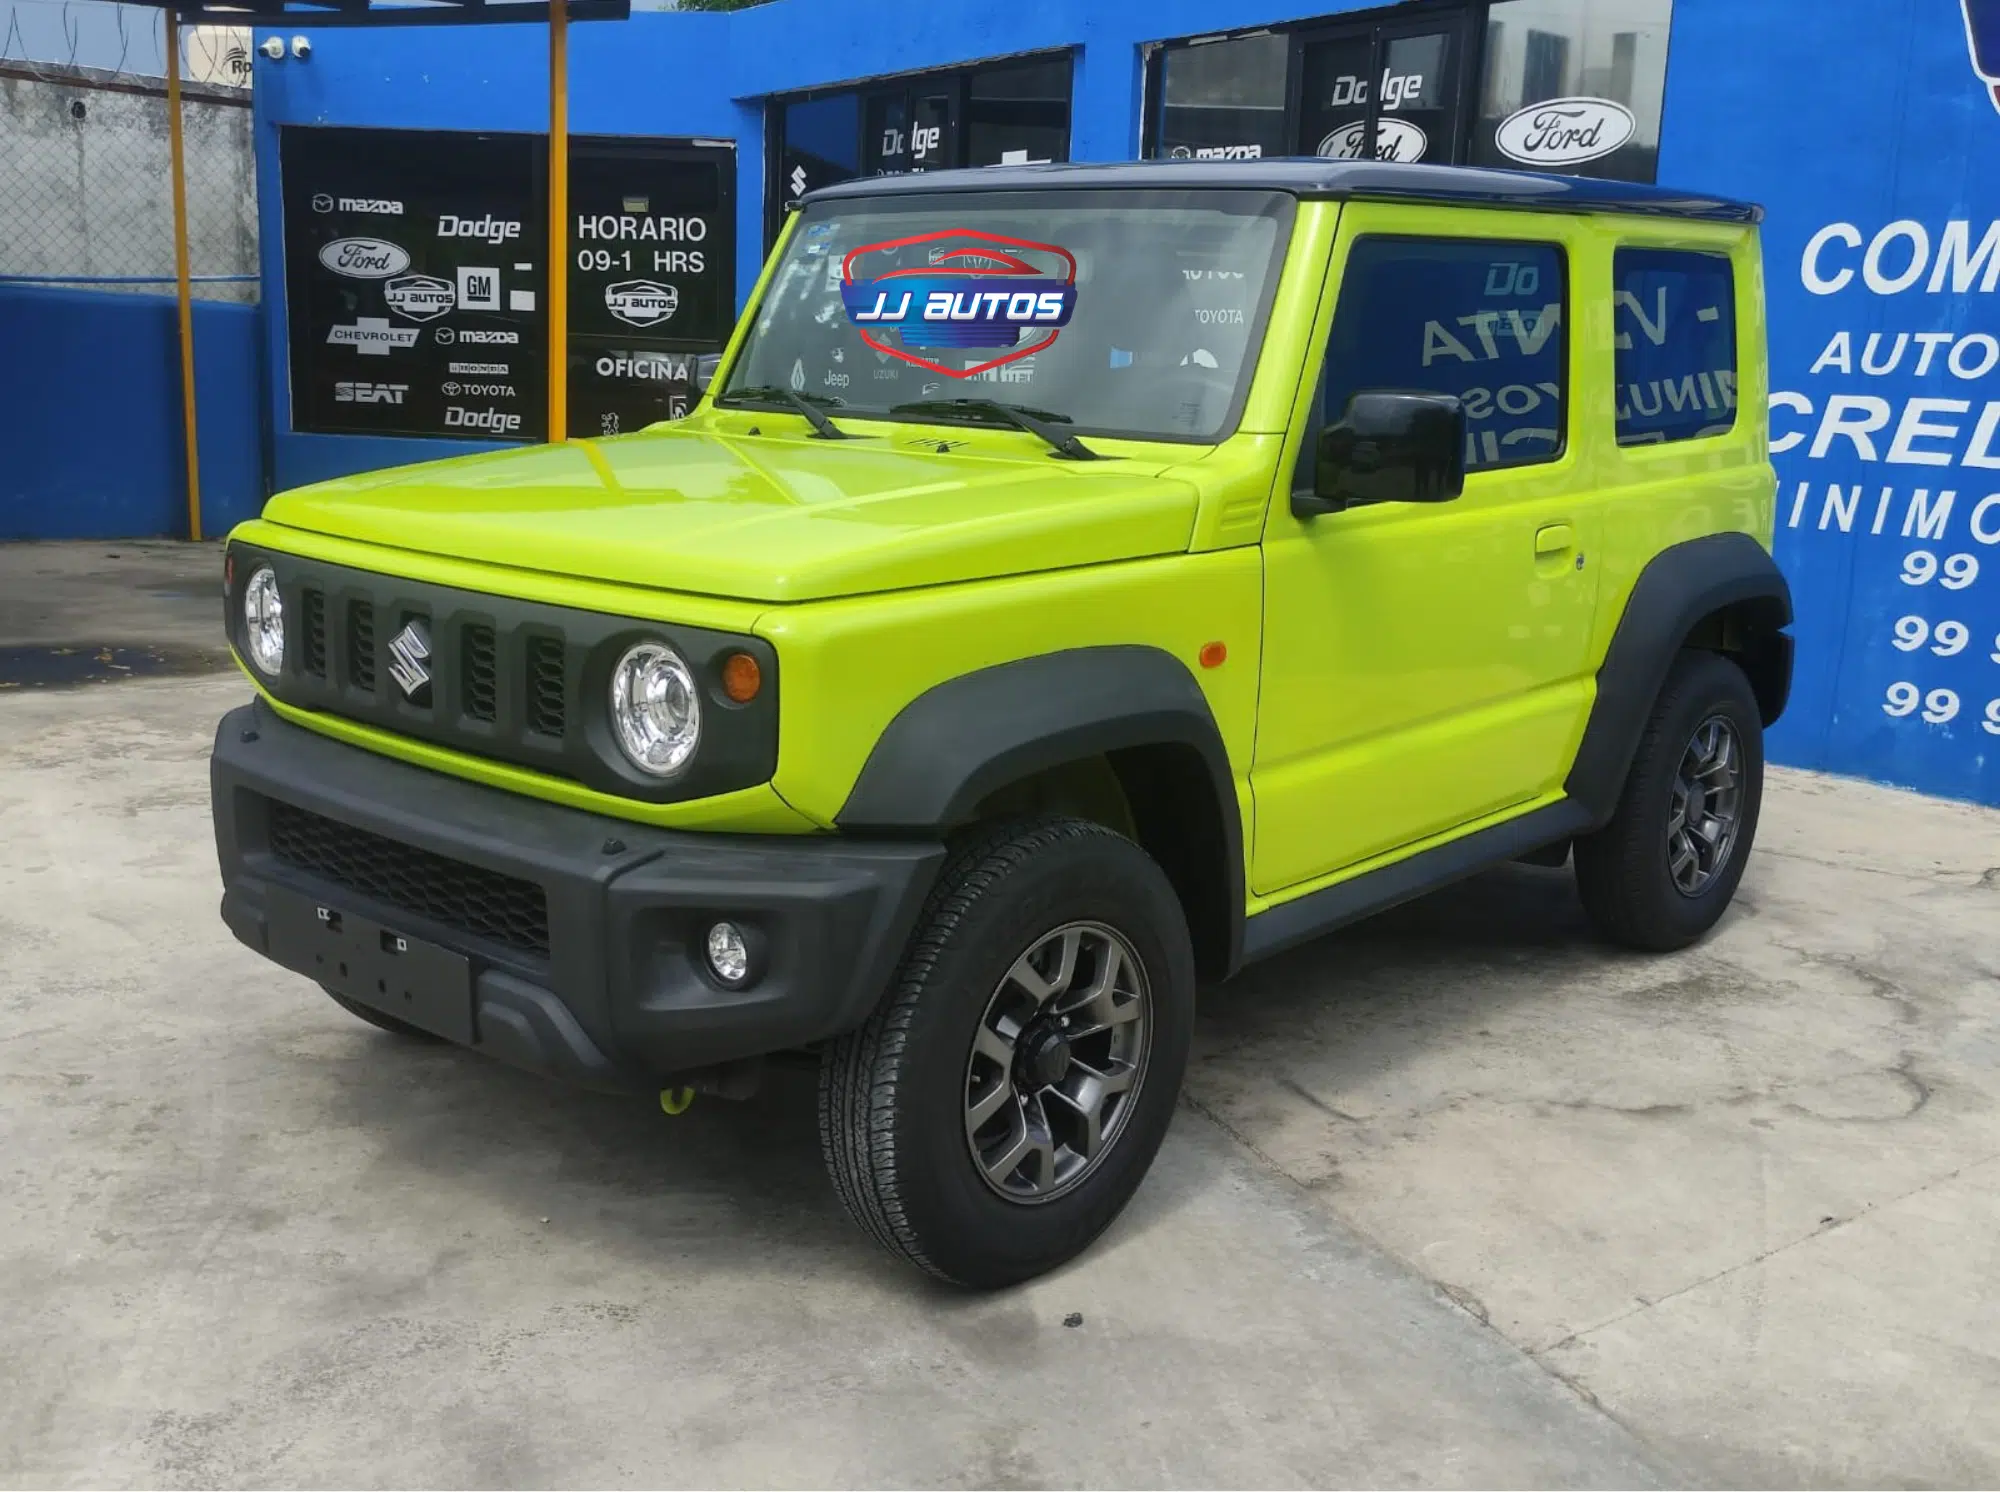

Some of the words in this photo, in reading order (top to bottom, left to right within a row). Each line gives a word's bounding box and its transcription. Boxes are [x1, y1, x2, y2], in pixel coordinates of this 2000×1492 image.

[1331, 68, 1423, 111] Doge
[1523, 110, 1605, 152] Ford
[339, 198, 404, 215] mazda
[437, 214, 521, 244] Dodge
[578, 215, 706, 242] HORARIO
[337, 243, 391, 270] Ford
[578, 250, 632, 272] 09-1
[654, 251, 705, 273] HRS
[467, 275, 491, 296] GM
[334, 329, 414, 344] CHEVROLET
[459, 330, 520, 345] mazda
[596, 357, 688, 381] OFICINA
[824, 370, 850, 388] Jeep
[335, 382, 409, 404] SEAT
[462, 384, 516, 397] TOYOTA
[445, 406, 521, 434] Dodge
[1900, 550, 1980, 590] 99
[1891, 615, 1970, 657] 99
[1881, 681, 1961, 724] 99
